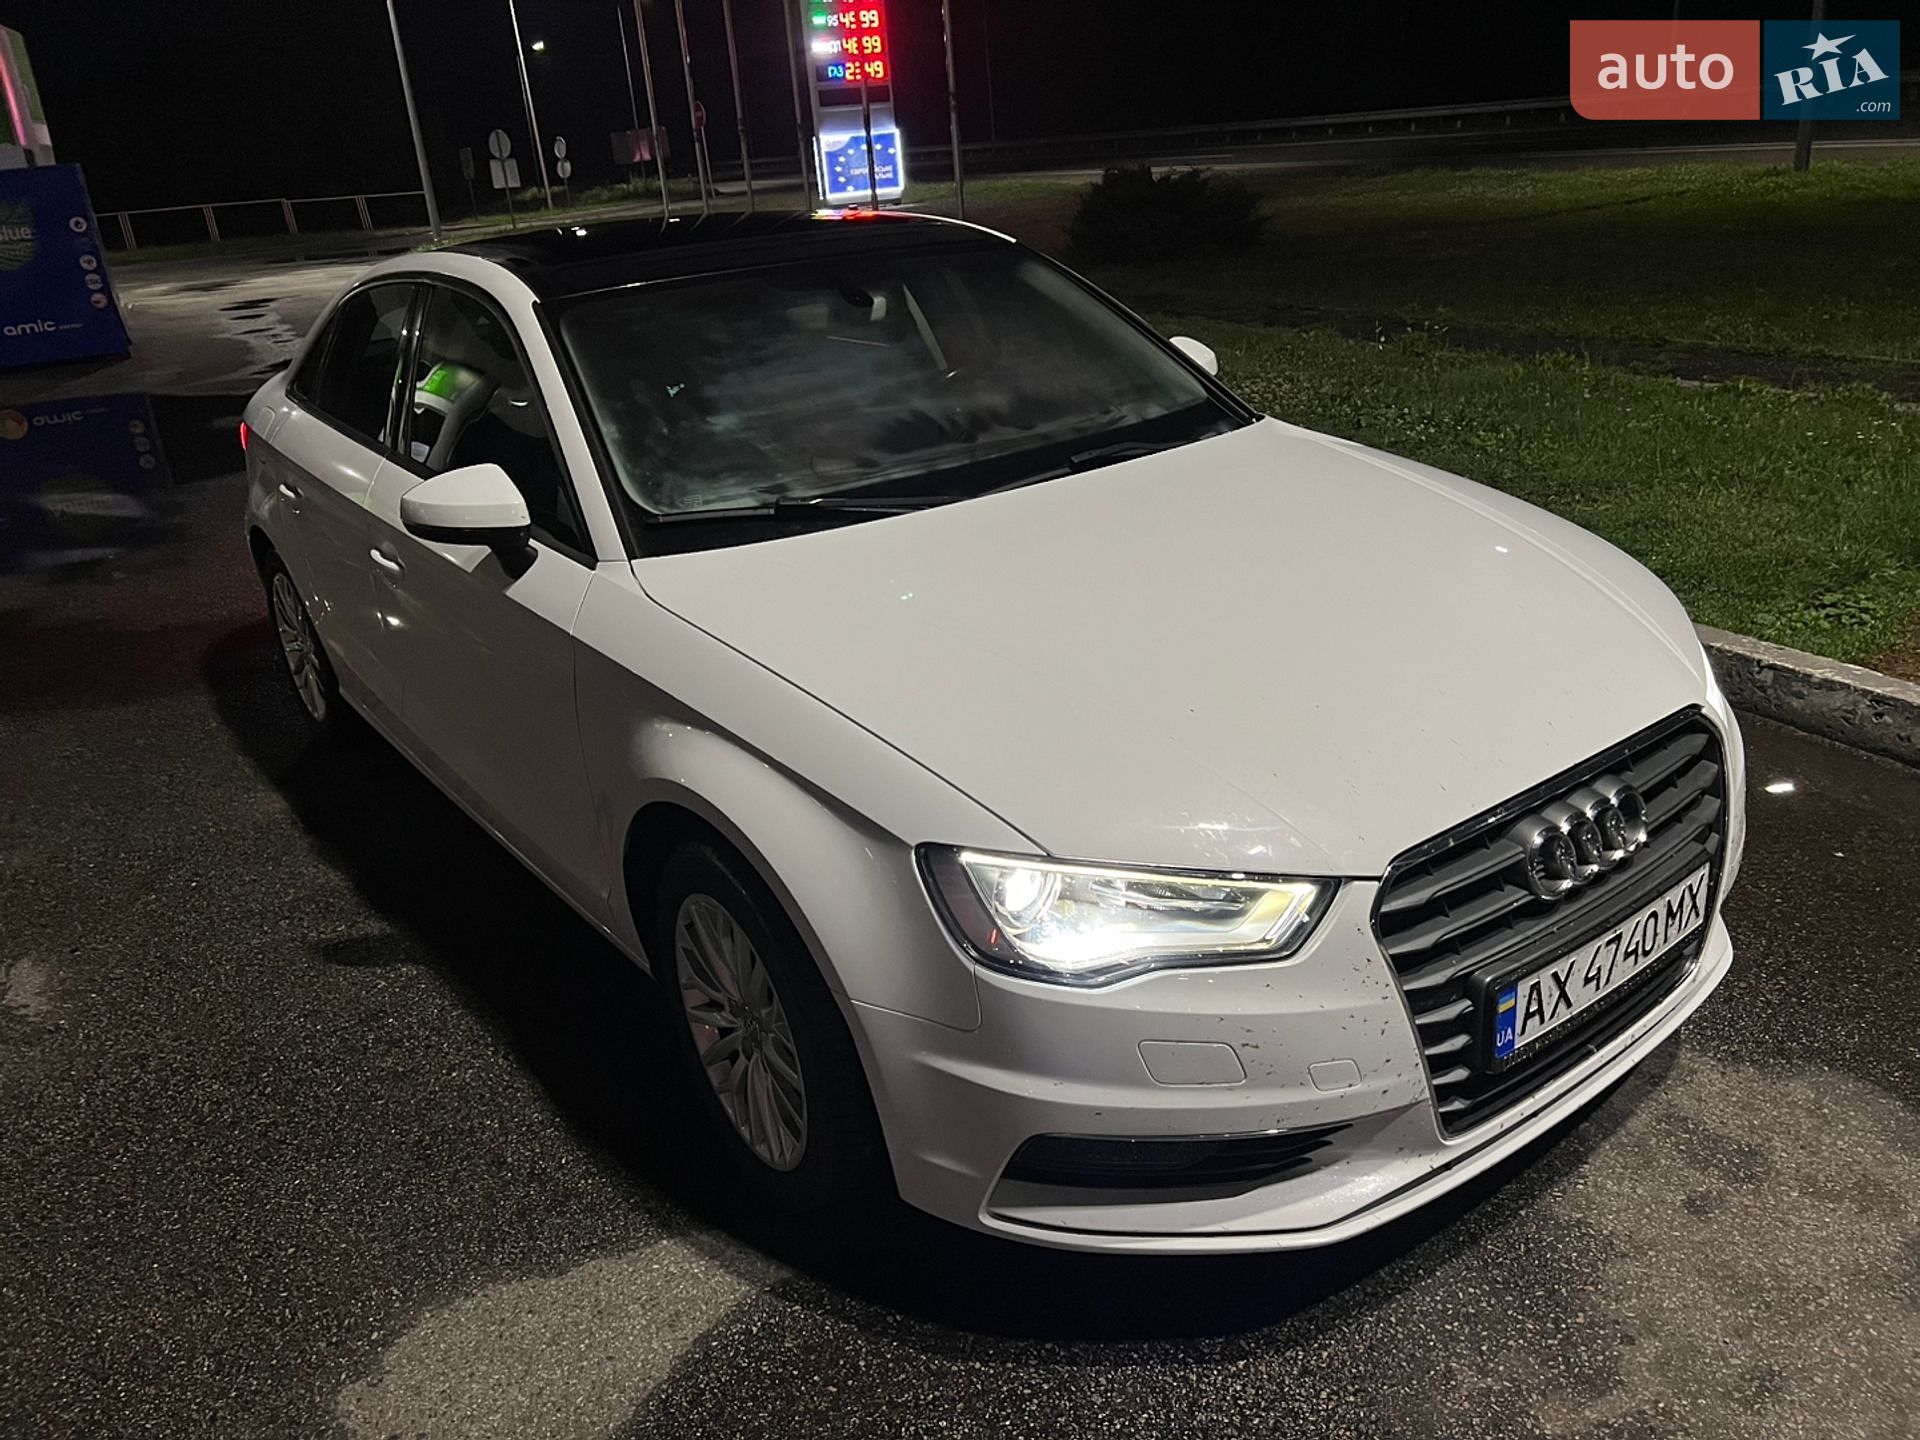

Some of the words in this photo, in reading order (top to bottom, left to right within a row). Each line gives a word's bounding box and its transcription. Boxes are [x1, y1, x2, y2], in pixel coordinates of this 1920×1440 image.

[0, 225, 32, 240] lue
[3, 319, 57, 336] amic
[1519, 958, 1576, 1037] AX
[1583, 910, 1659, 992] 4740
[1664, 872, 1705, 945] MX
[1496, 1027, 1513, 1047] UA
